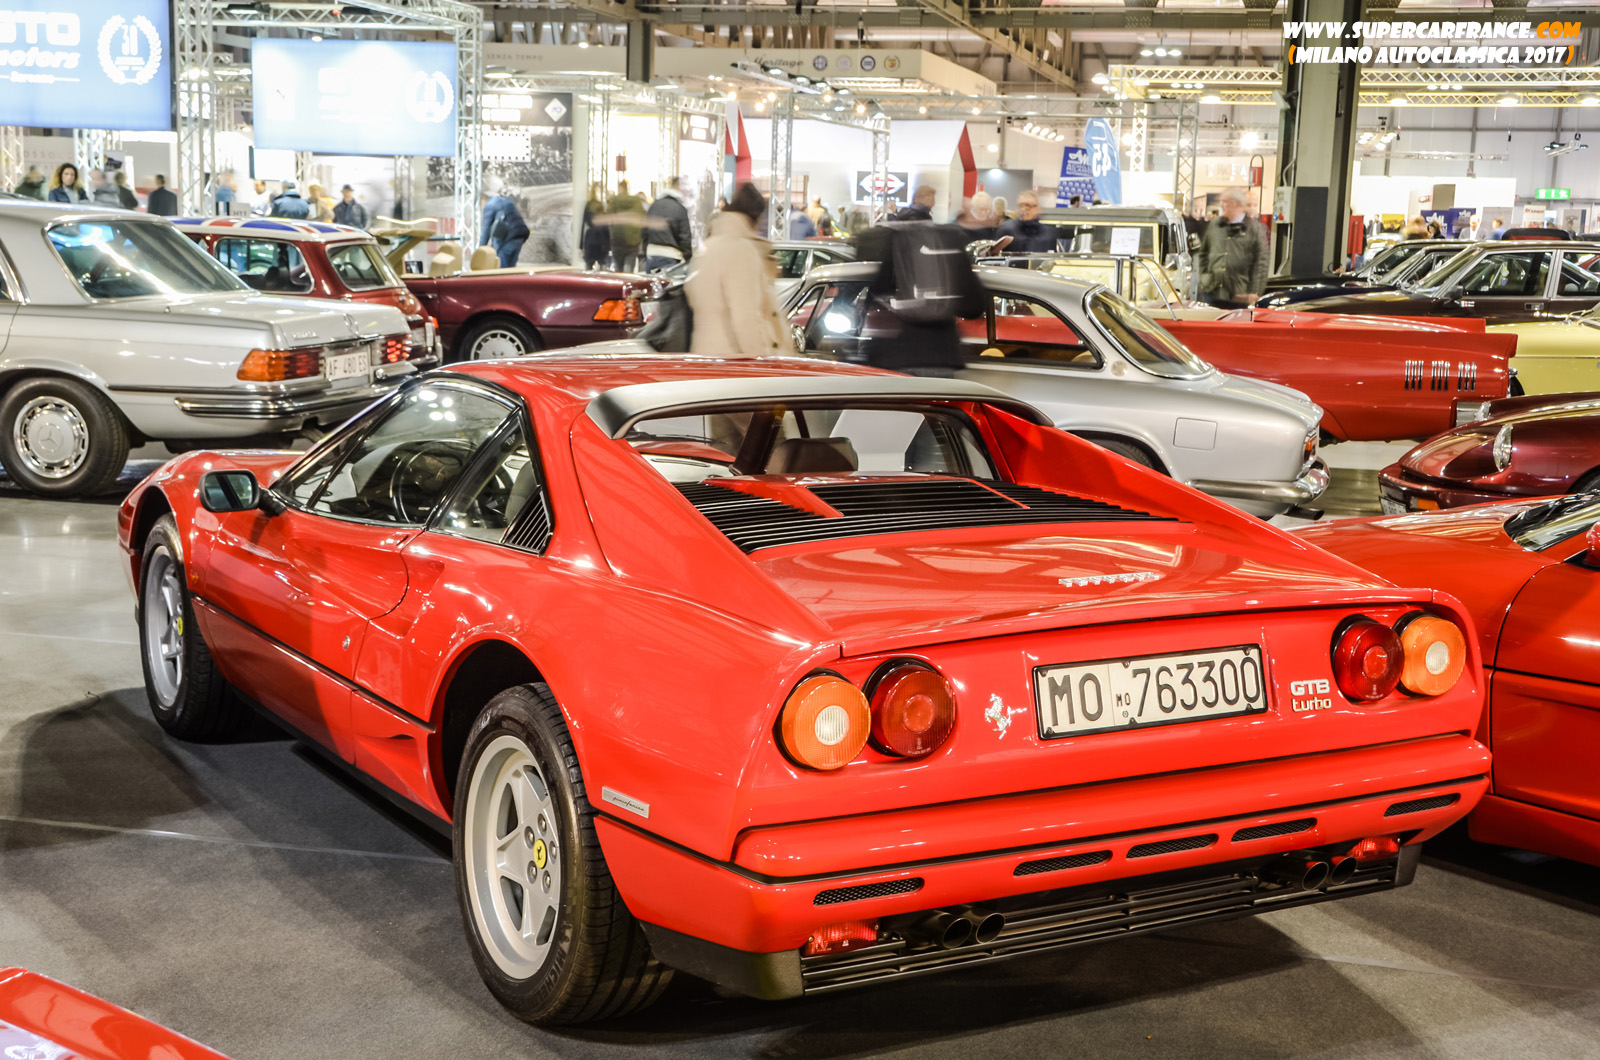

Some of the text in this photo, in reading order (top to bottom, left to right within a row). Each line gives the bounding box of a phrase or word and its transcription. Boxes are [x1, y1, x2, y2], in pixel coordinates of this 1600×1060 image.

[1048, 656, 1261, 726] MO 763300
[1290, 678, 1331, 696] GTB
[1115, 692, 1131, 708] MO
[1292, 696, 1332, 712] turbo
